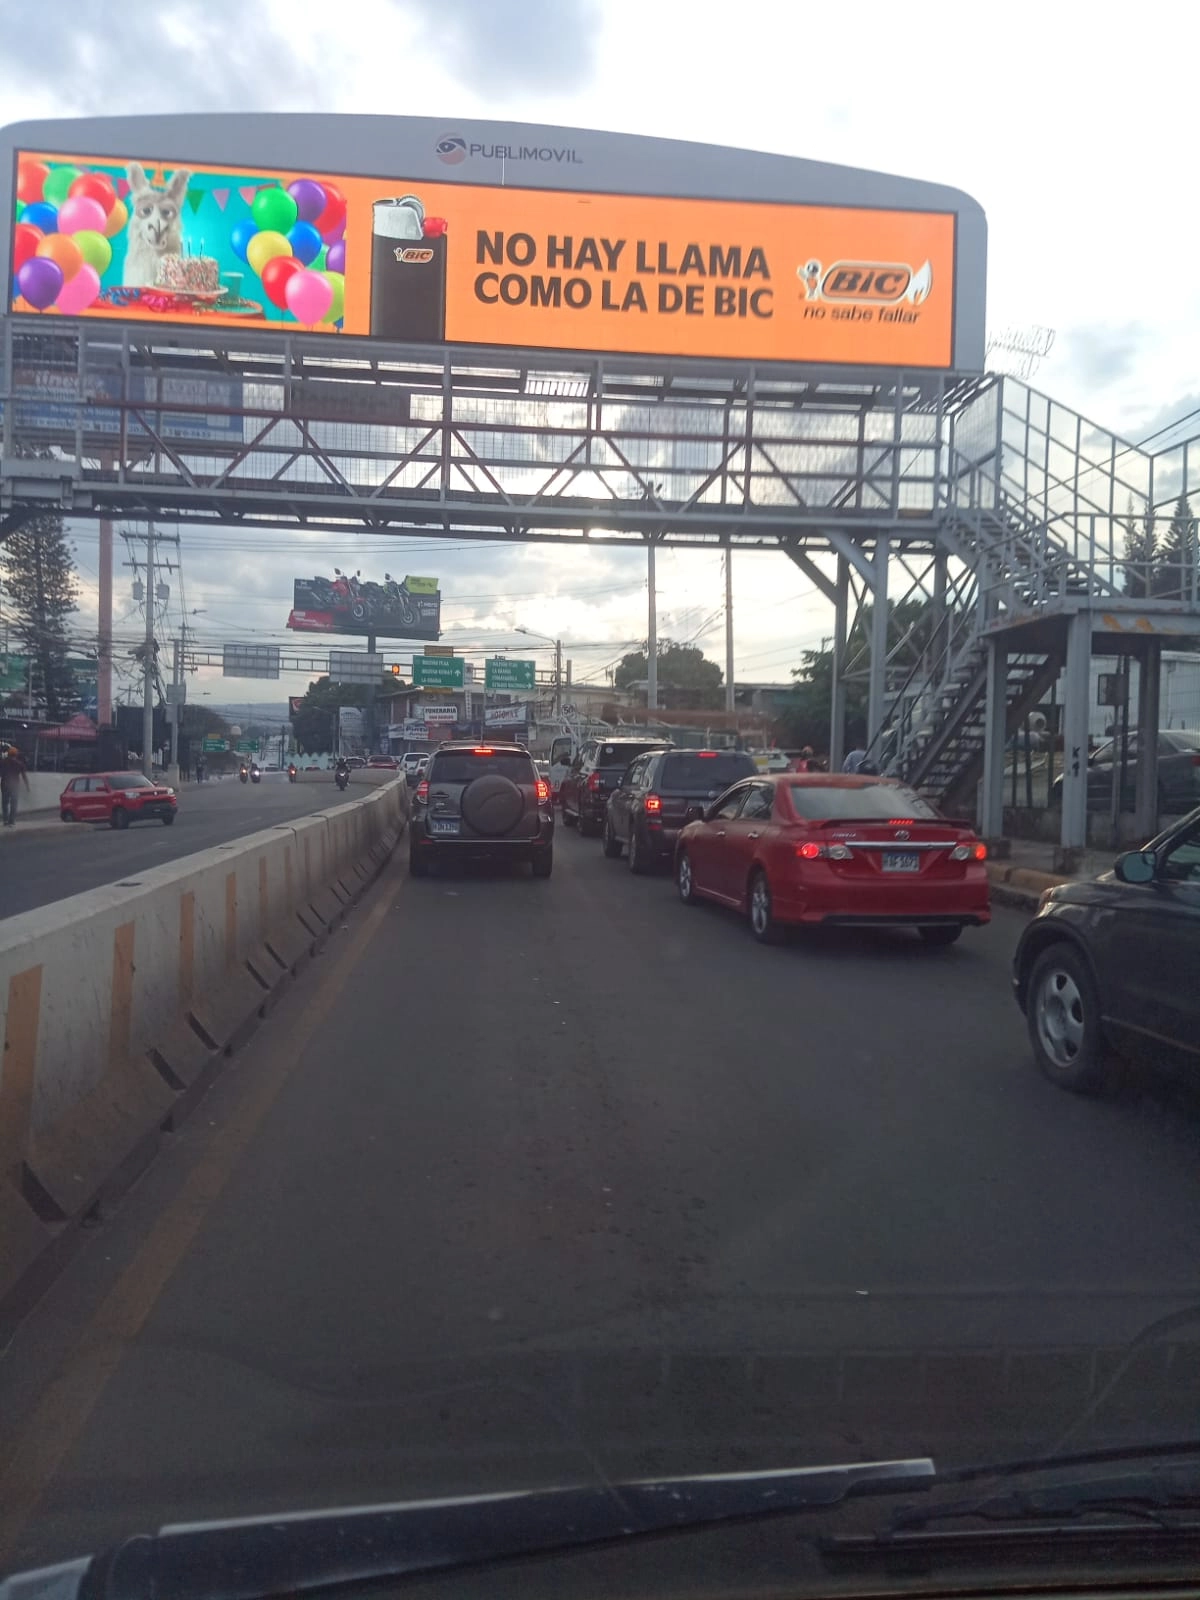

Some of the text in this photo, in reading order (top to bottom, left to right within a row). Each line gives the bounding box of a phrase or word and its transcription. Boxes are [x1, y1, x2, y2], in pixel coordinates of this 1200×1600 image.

[469, 143, 584, 164] PUBLIMOVIL
[405, 251, 431, 260] BIC
[476, 230, 771, 280] NO HAY LLAMA
[830, 270, 903, 295] BIC
[474, 272, 774, 319] COMO LA DE BIC
[803, 306, 921, 324] no sabe fallar
